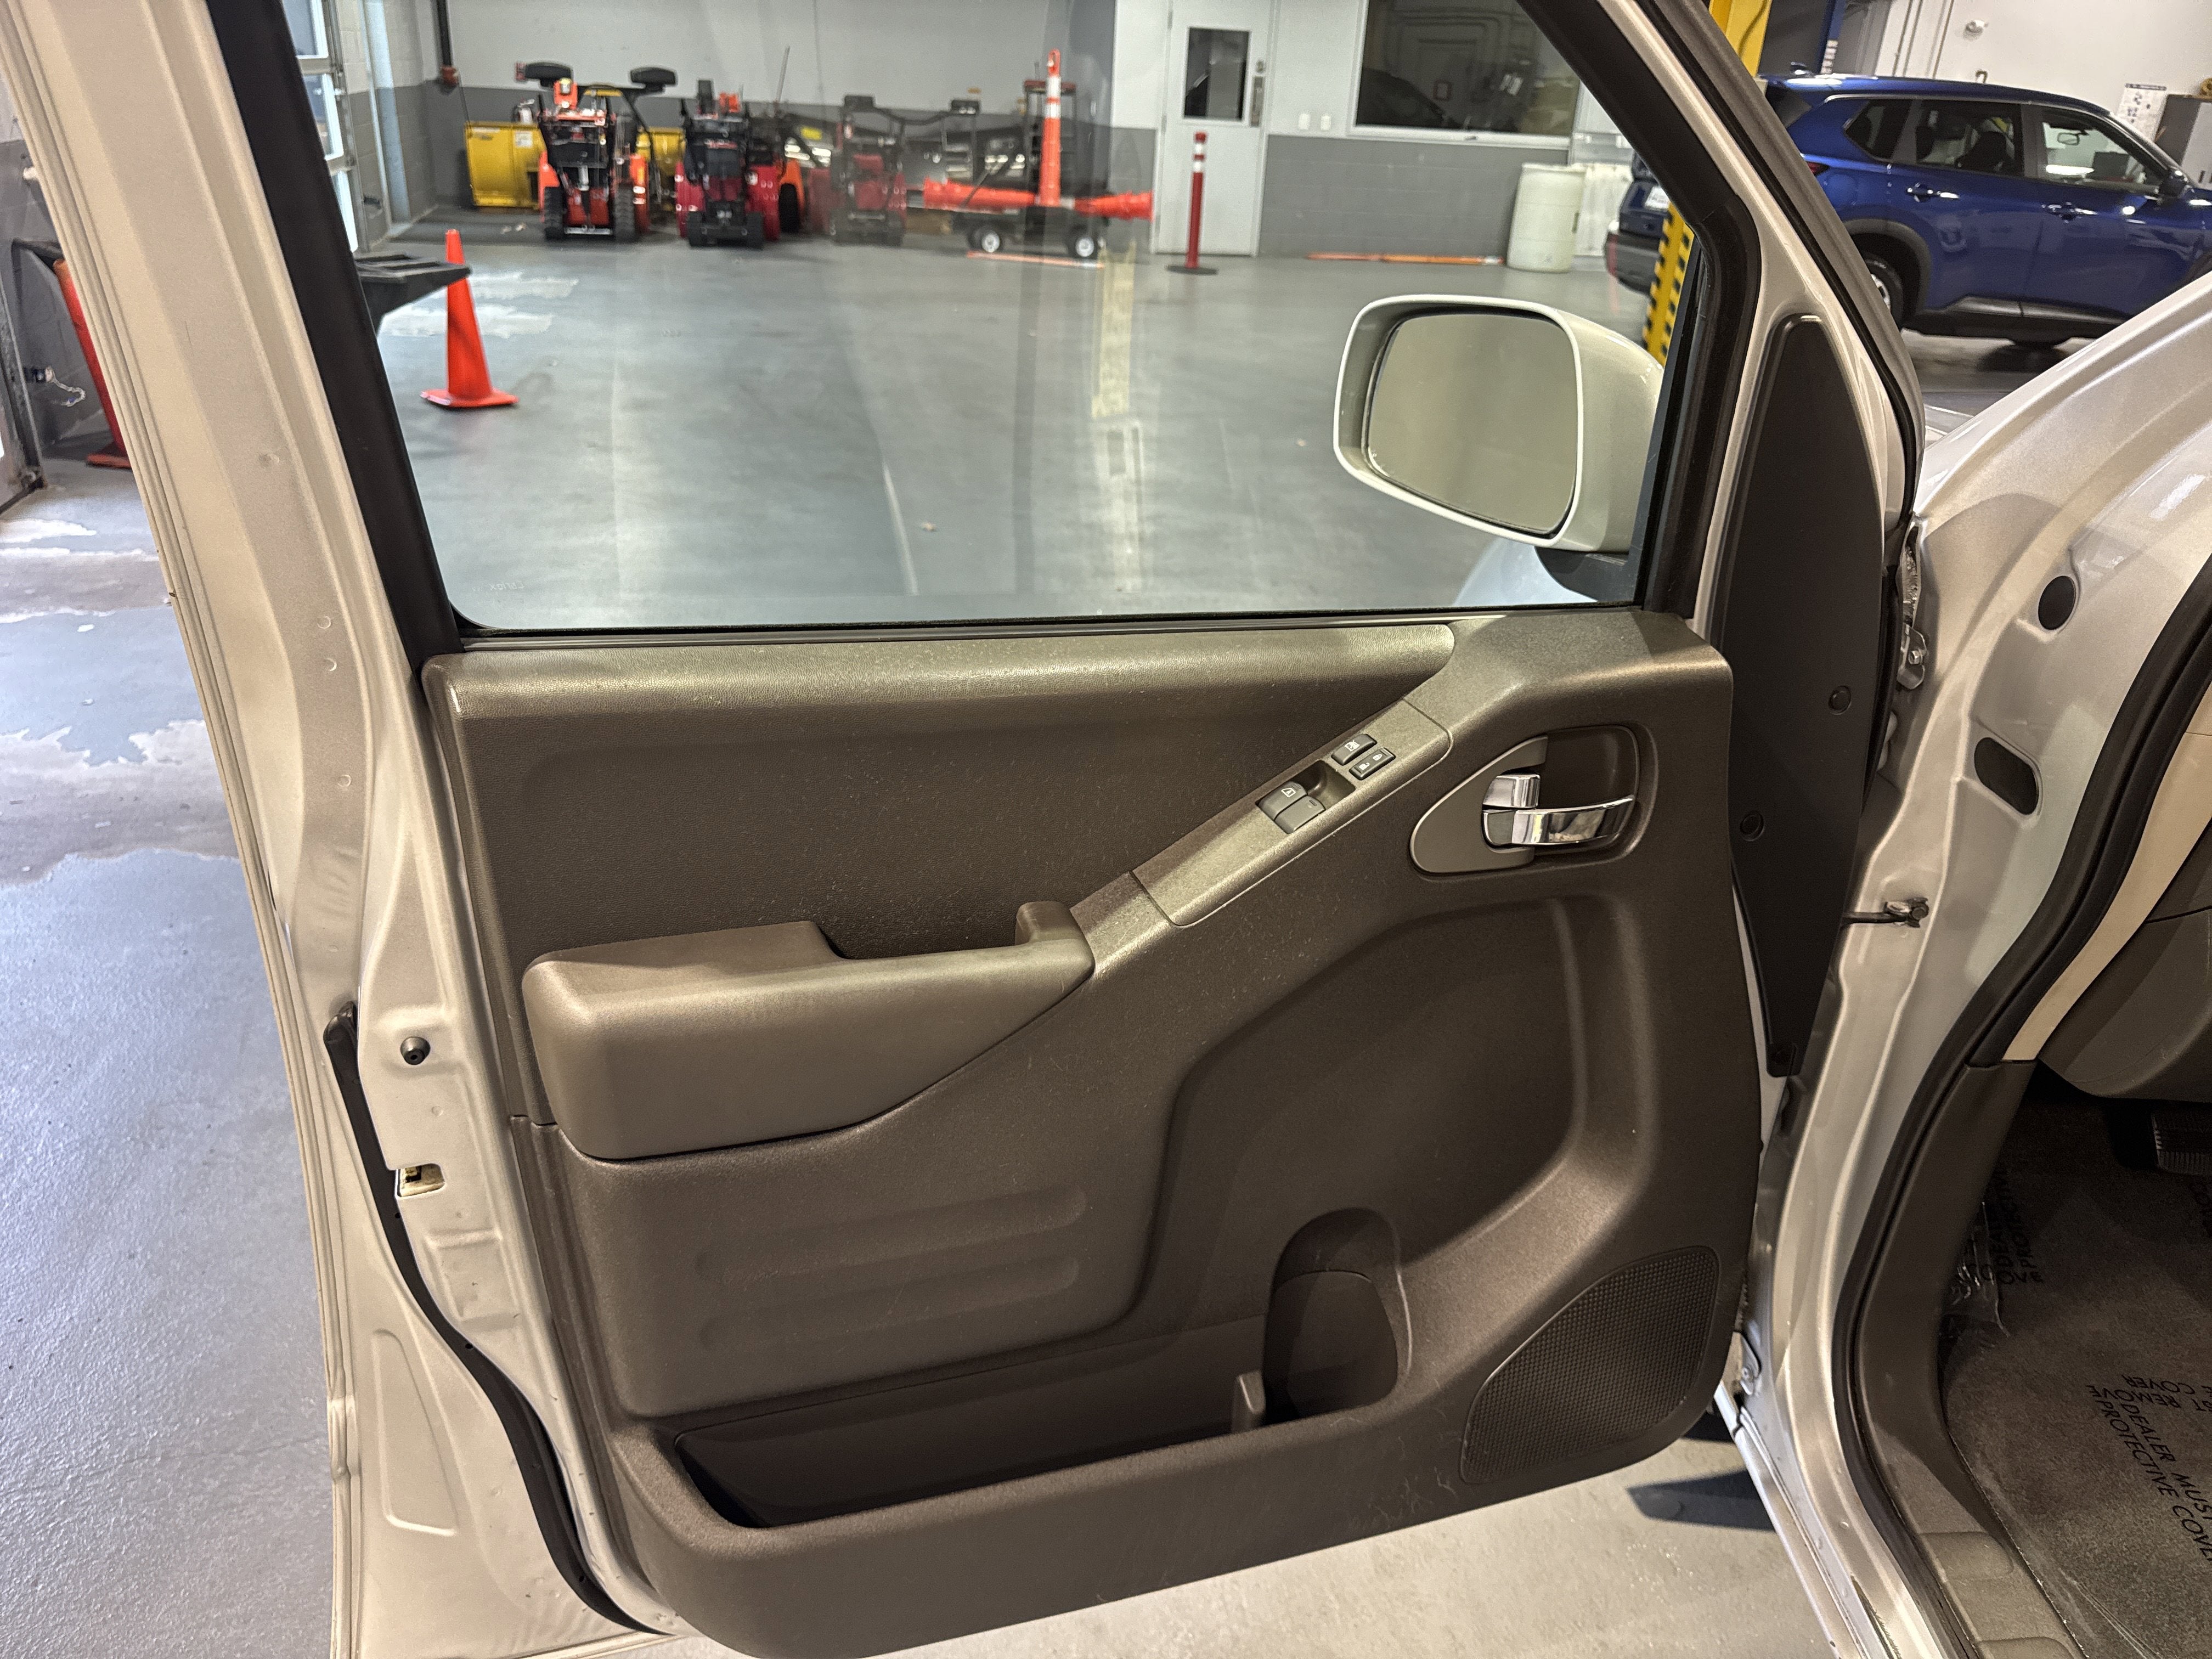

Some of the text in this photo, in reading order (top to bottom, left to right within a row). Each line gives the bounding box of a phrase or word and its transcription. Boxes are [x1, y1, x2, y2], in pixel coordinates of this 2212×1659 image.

[2085, 1385, 2181, 1408] REMOVE
[2121, 1374, 2196, 1395] COVER
[2095, 1400, 2180, 1498] PROTECTIVE
[2120, 1403, 2176, 1462] DEALER
